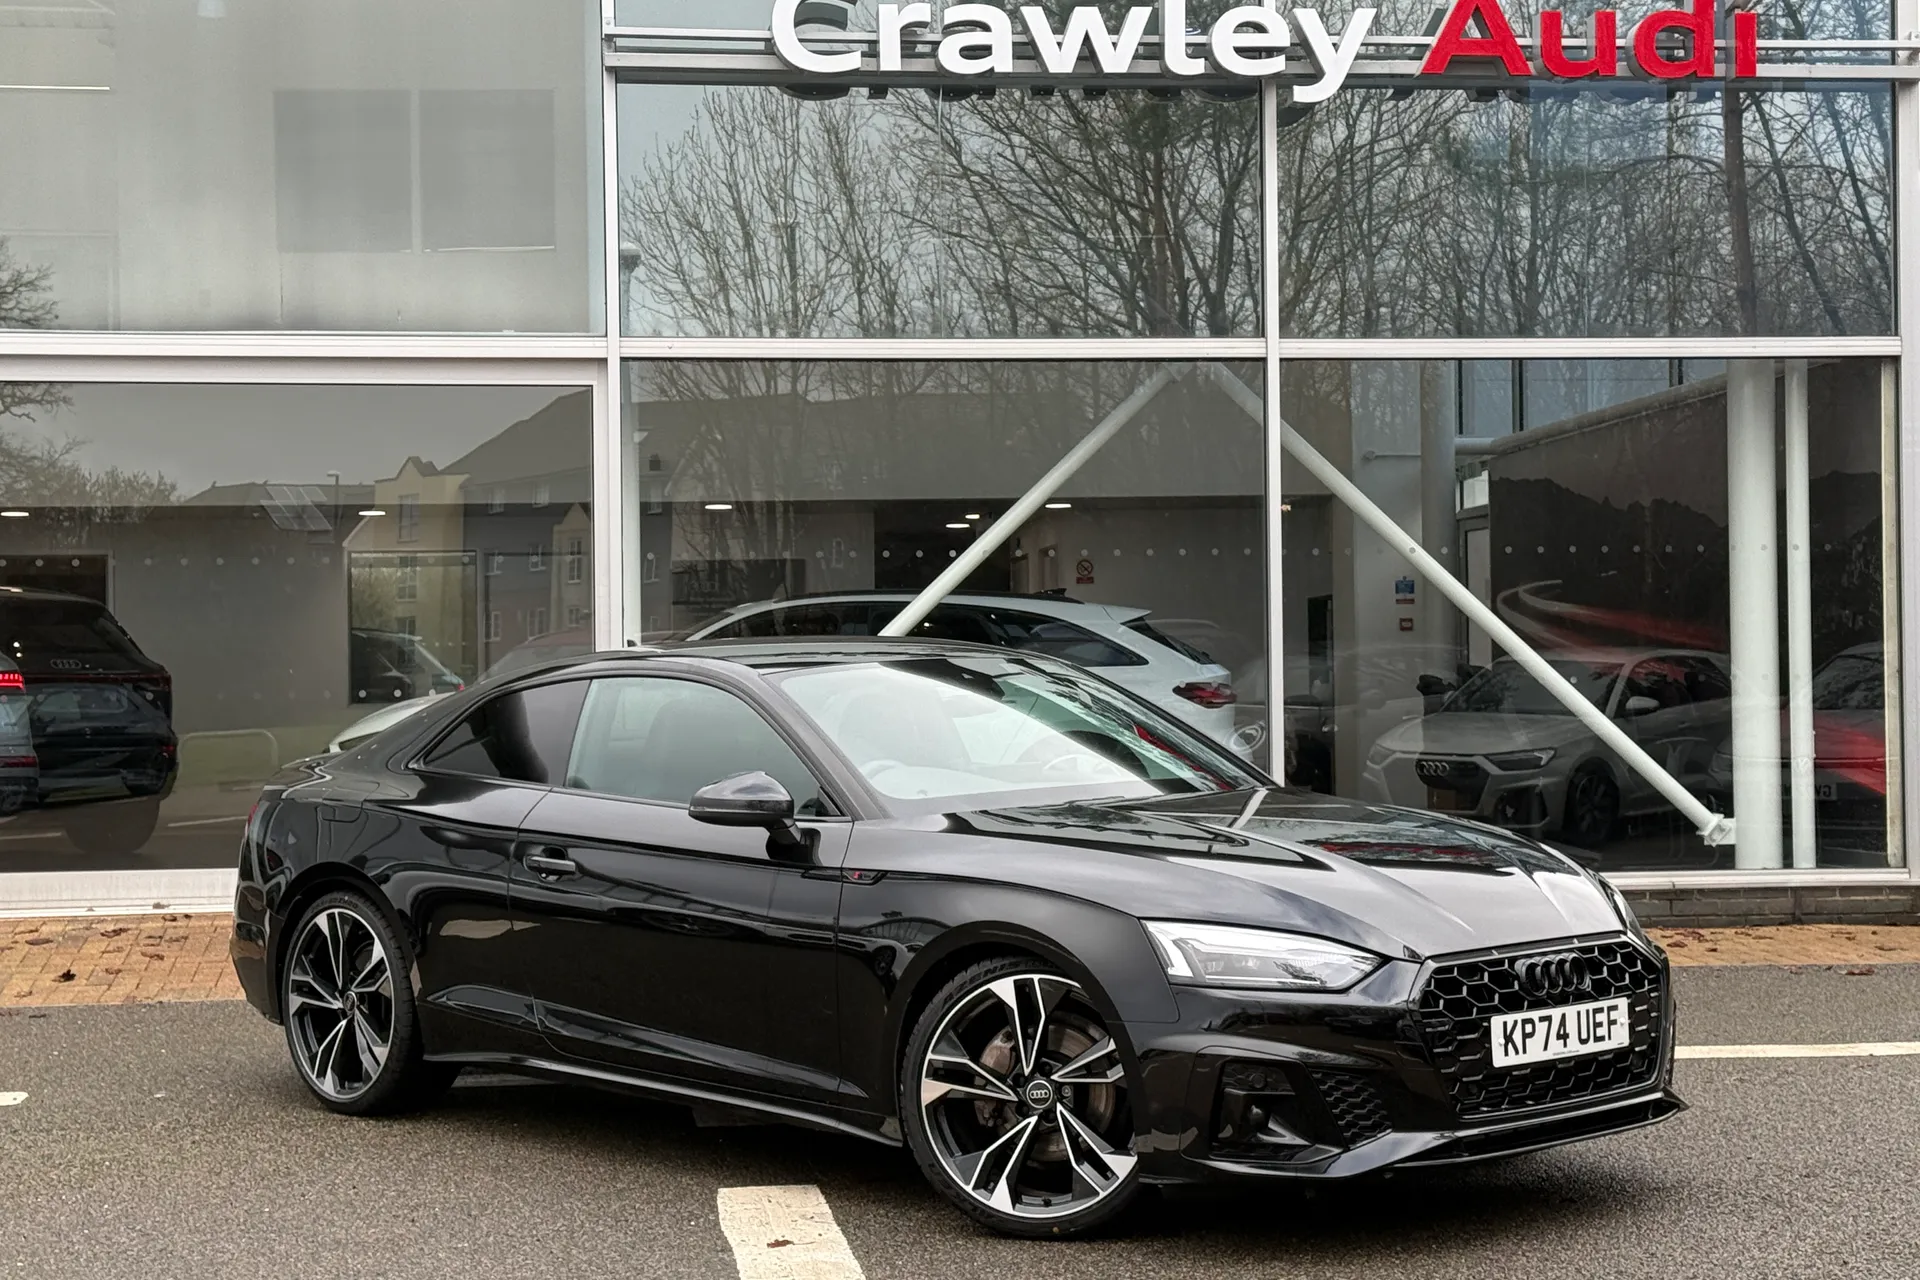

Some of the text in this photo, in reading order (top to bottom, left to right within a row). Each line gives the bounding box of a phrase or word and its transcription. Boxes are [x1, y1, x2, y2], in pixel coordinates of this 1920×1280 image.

[771, 0, 1757, 103] Crawley Audi
[1502, 1004, 1619, 1057] KP74 UEF
